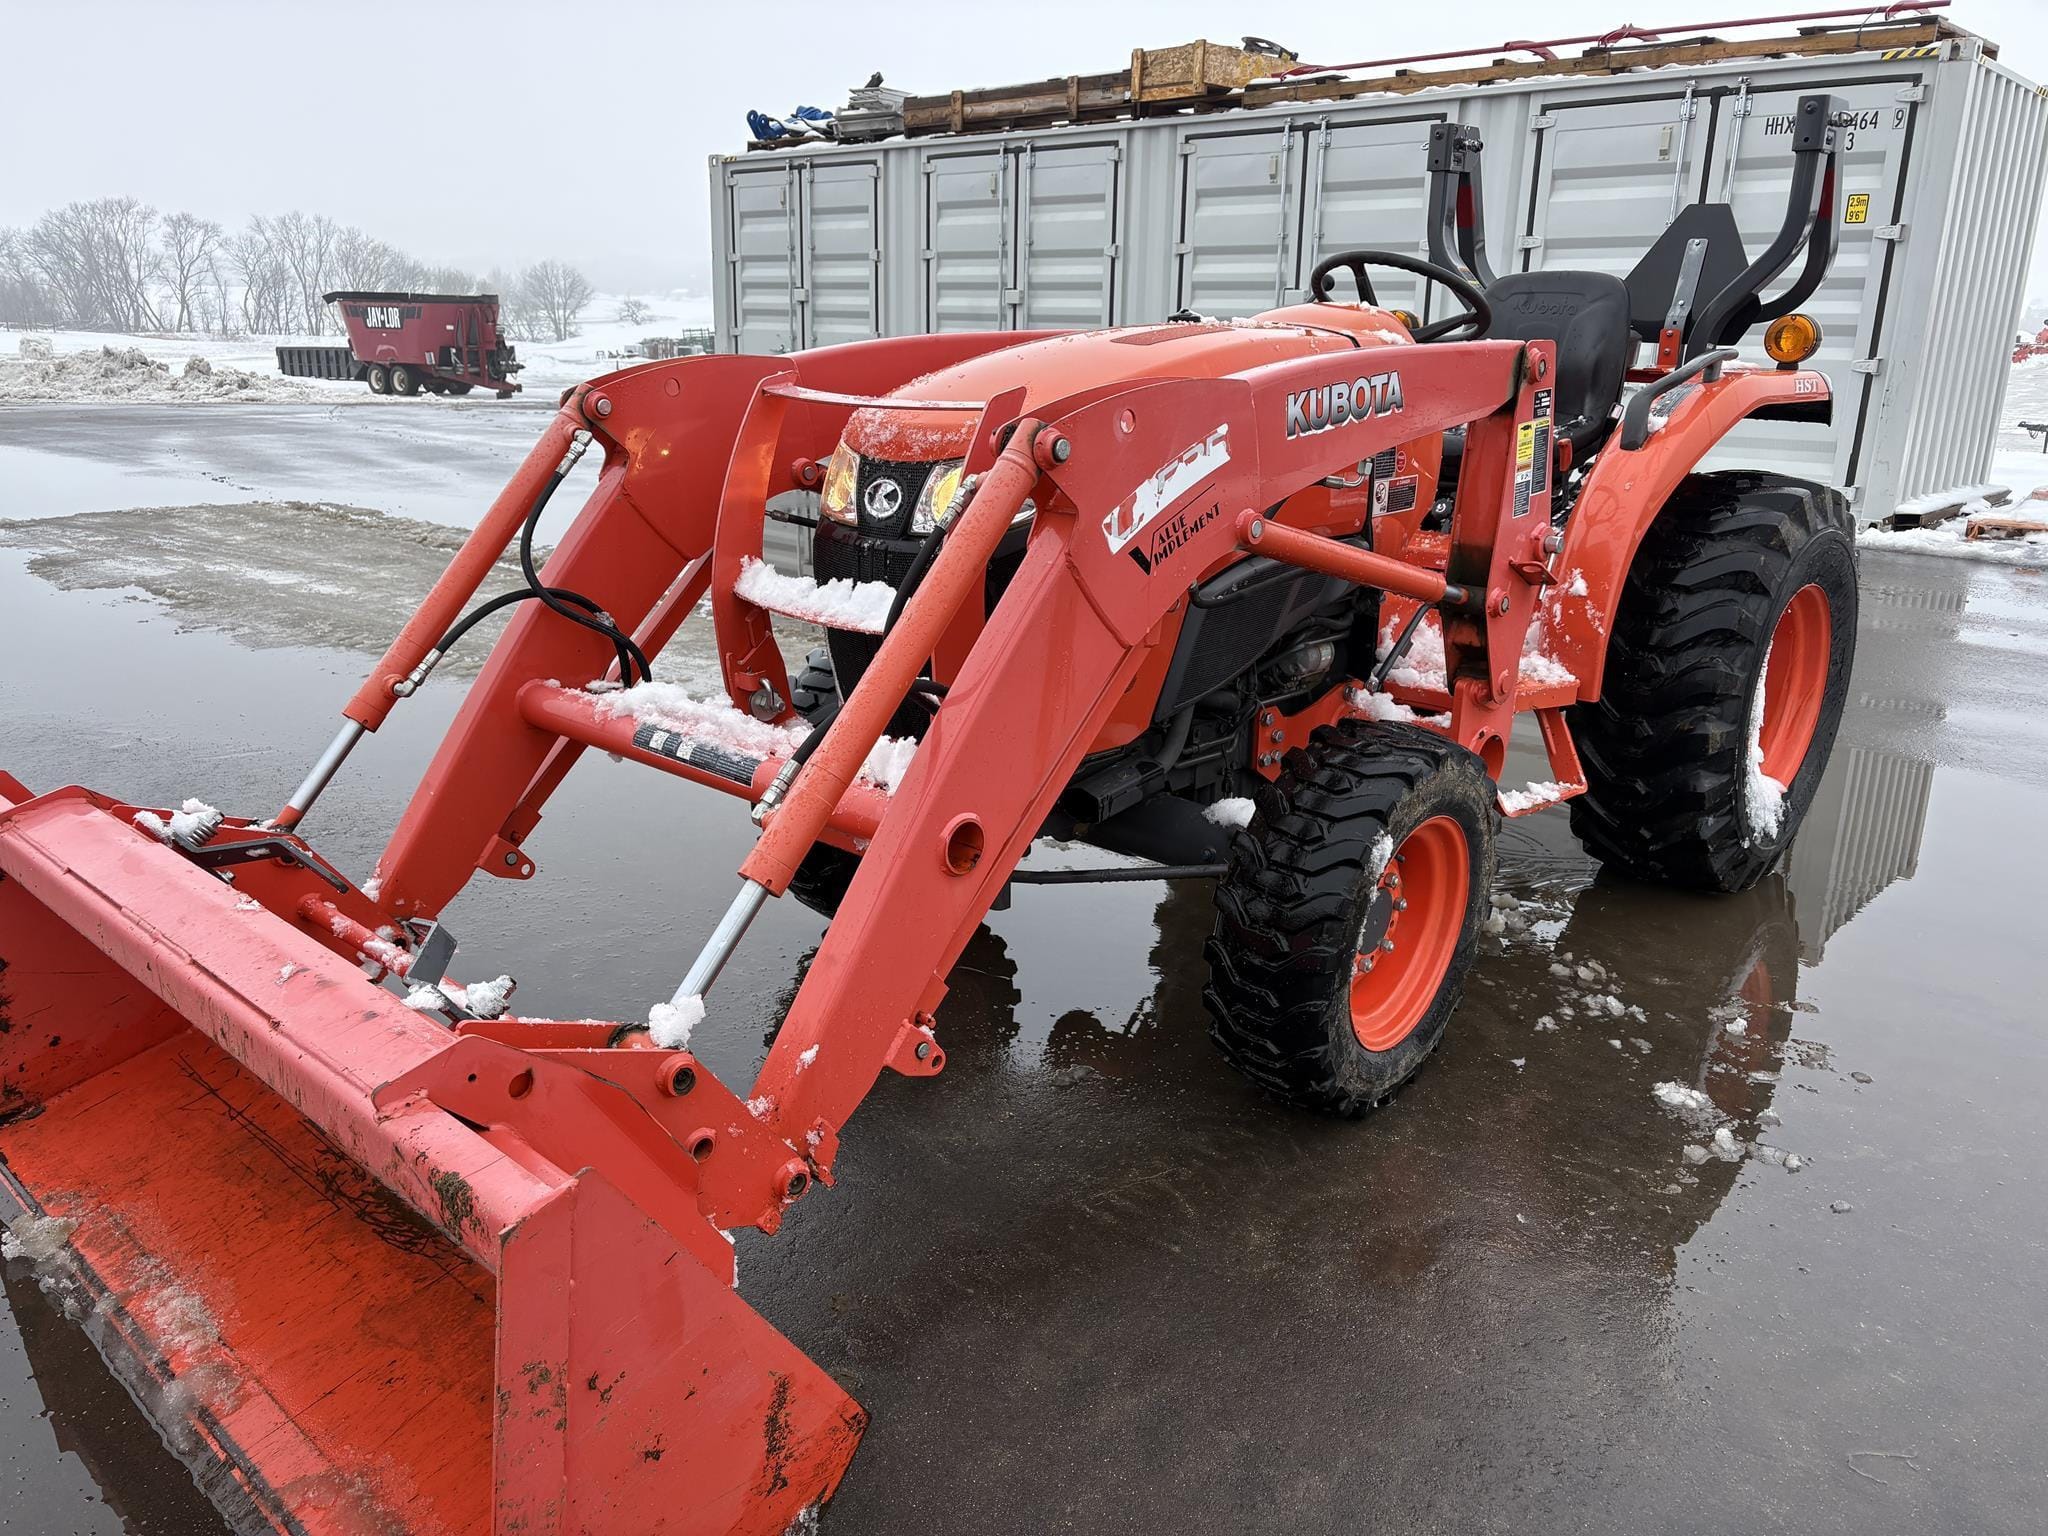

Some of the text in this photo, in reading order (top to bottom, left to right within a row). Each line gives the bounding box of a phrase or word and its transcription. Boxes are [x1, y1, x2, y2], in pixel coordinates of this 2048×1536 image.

[1894, 109, 1905, 128] 9
[1513, 296, 1577, 316] Kubota
[1794, 378, 1818, 394] HST
[1285, 370, 1404, 440] KUBOTA
